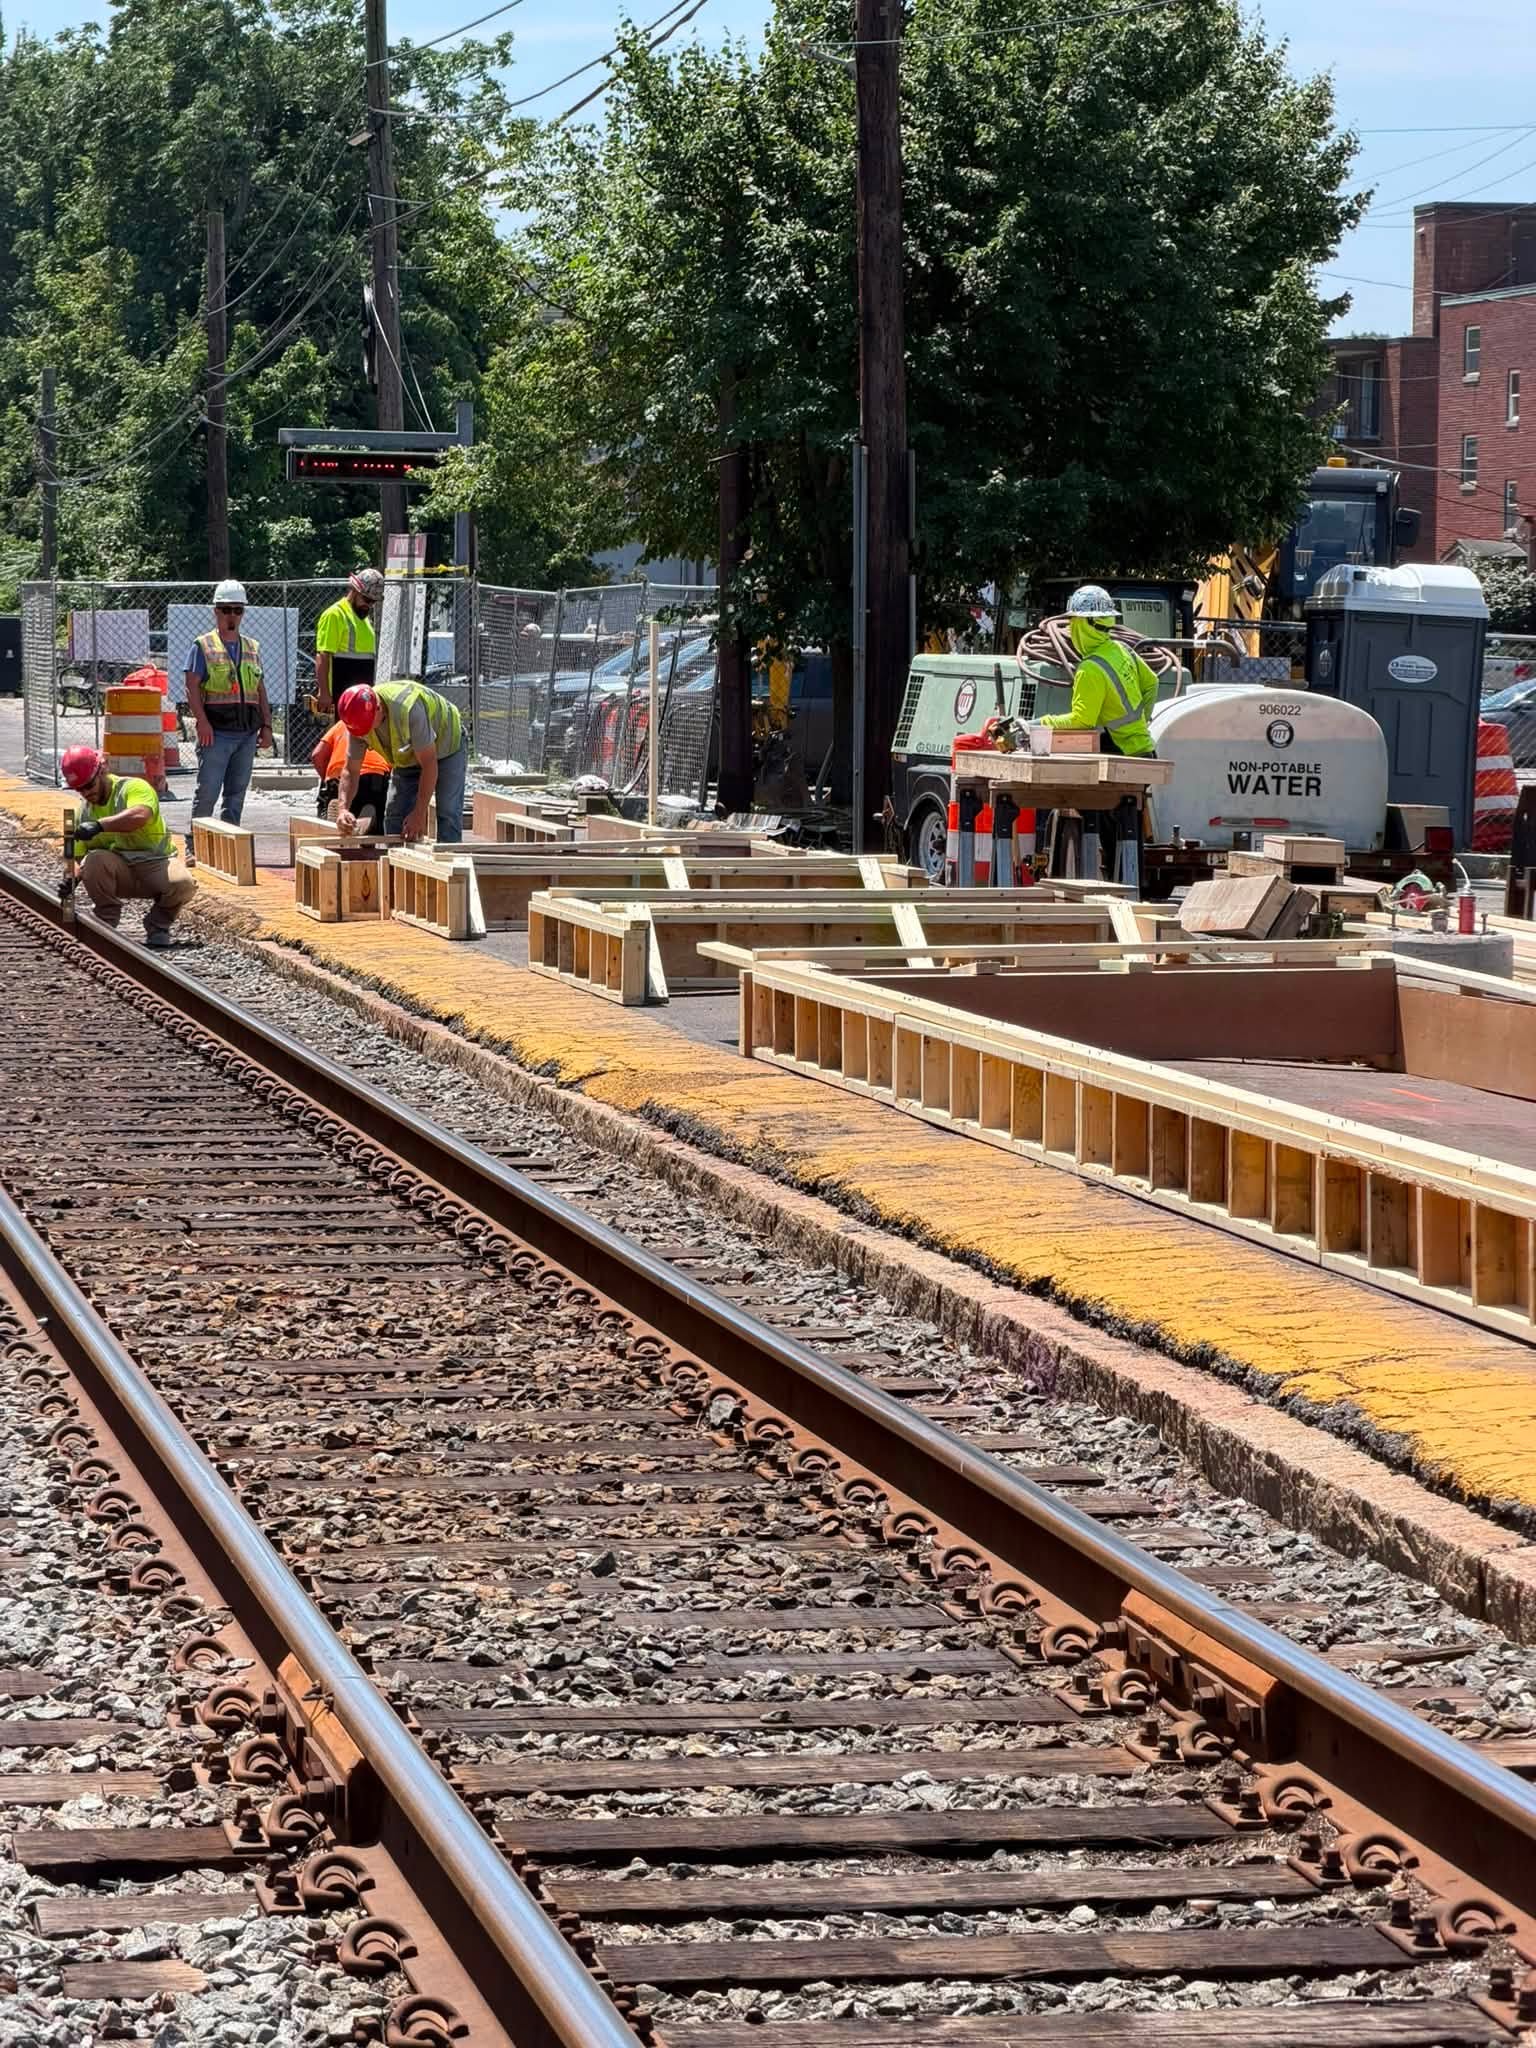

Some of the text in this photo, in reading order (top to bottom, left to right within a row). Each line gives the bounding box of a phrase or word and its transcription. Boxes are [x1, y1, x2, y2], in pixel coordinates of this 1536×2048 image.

[1259, 704, 1302, 716] 906022
[1229, 761, 1322, 774] NON-POTABLE
[1227, 775, 1322, 797] WATER
